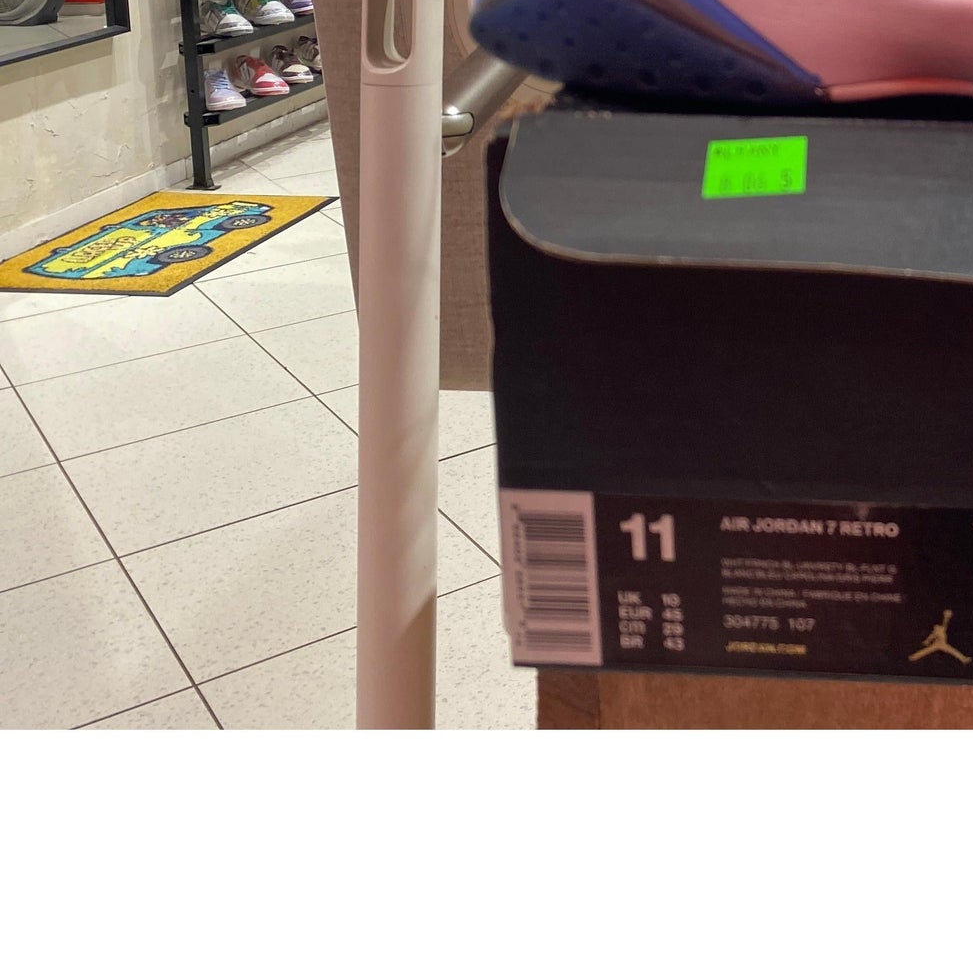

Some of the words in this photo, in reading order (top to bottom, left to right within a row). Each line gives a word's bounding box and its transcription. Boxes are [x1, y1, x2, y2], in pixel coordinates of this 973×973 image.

[720, 516, 750, 531] AIR
[752, 517, 824, 535] JORDAN
[826, 520, 838, 536] 7
[840, 520, 899, 538] RETRO
[619, 512, 676, 562] 11
[617, 590, 642, 605] UK
[618, 605, 653, 621] EUR
